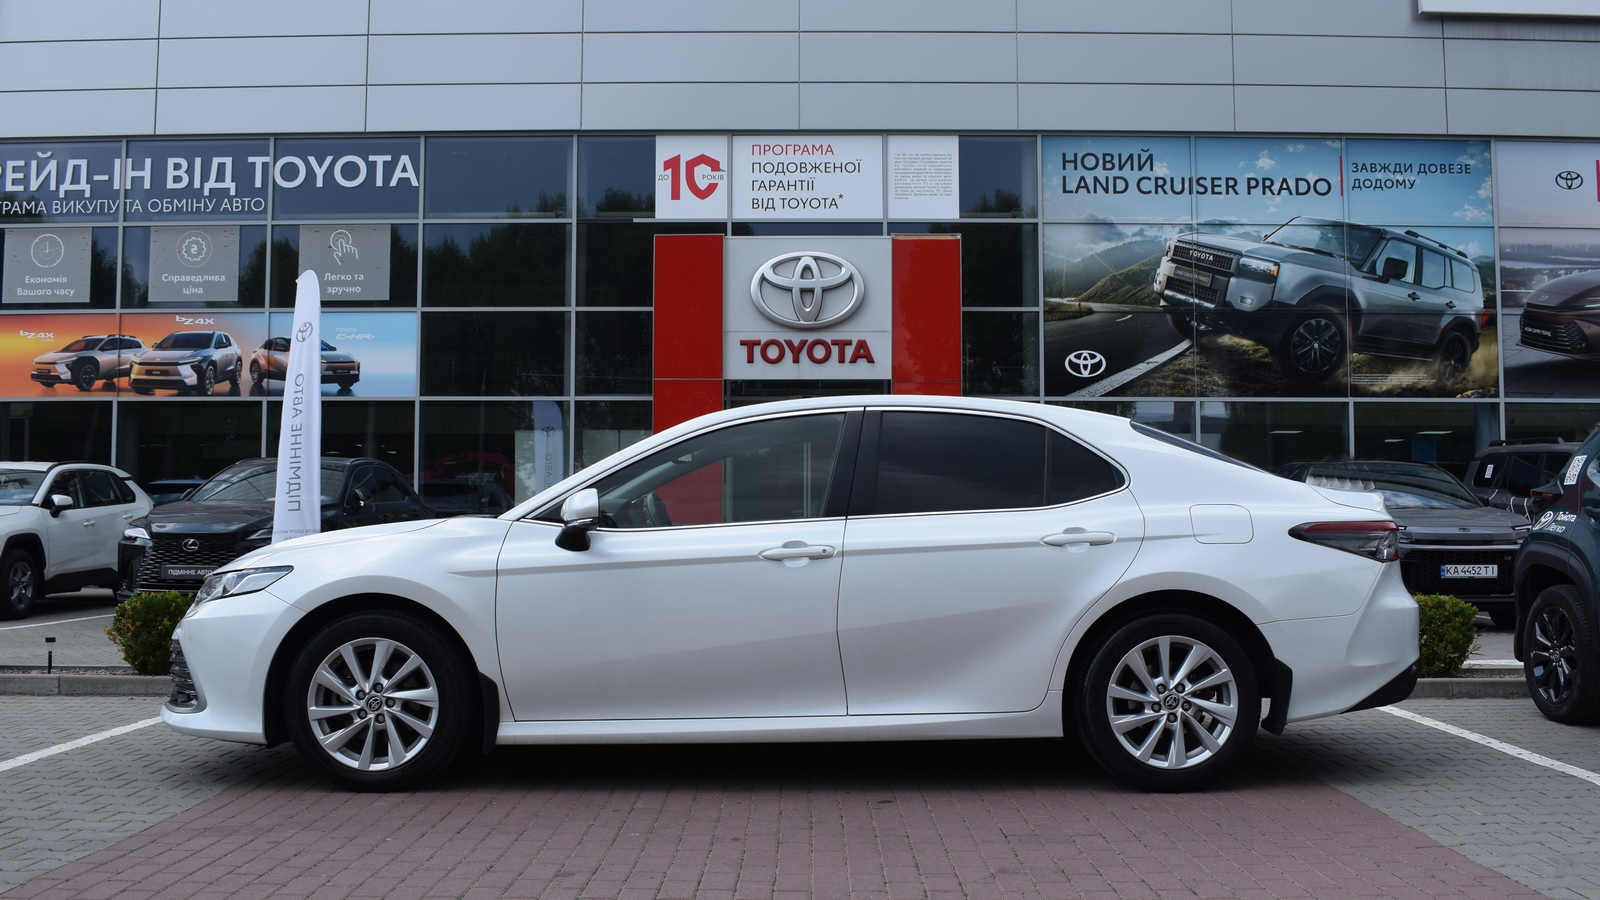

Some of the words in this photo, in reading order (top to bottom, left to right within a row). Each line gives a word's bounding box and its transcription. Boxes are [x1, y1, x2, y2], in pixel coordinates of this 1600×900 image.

[751, 144, 835, 156] ПРОГРАМА
[1061, 149, 1154, 172] НОВИЙ
[751, 159, 862, 176] ПОДОВЖЕНОЇ
[1351, 162, 1413, 175] ЗАВЖДИ
[1417, 163, 1472, 176] ДОВЕЗЕ
[0, 151, 152, 198] ЕЙД-ІН
[166, 157, 236, 196] ВІД
[248, 155, 419, 188] TOYOTA
[658, 174, 670, 182] ДО
[751, 177, 816, 192] ГАРАНТІЇ
[1061, 176, 1129, 194] LAND
[1136, 176, 1239, 196] CRUISER
[1246, 177, 1332, 196] PRADO
[1352, 178, 1417, 191] ДОДОМУ
[52, 199, 120, 214] ВИКУПУ
[124, 199, 143, 213] ТА
[148, 198, 217, 213] ОБМІНУ
[220, 197, 266, 212] АВТО
[751, 197, 776, 211] ВІД
[1189, 250, 1214, 261] TOYOTA
[25, 275, 67, 284] Економія
[162, 273, 226, 283] Справедлива
[324, 272, 352, 281] Легко
[354, 273, 364, 281] та
[17, 287, 52, 296] Вашого
[54, 288, 75, 297] часу
[183, 285, 204, 295] ціна
[326, 286, 362, 295] зручно
[740, 339, 875, 364] TOYOTA
[1445, 566, 1459, 575] KA
[1461, 566, 1482, 575] 4452
